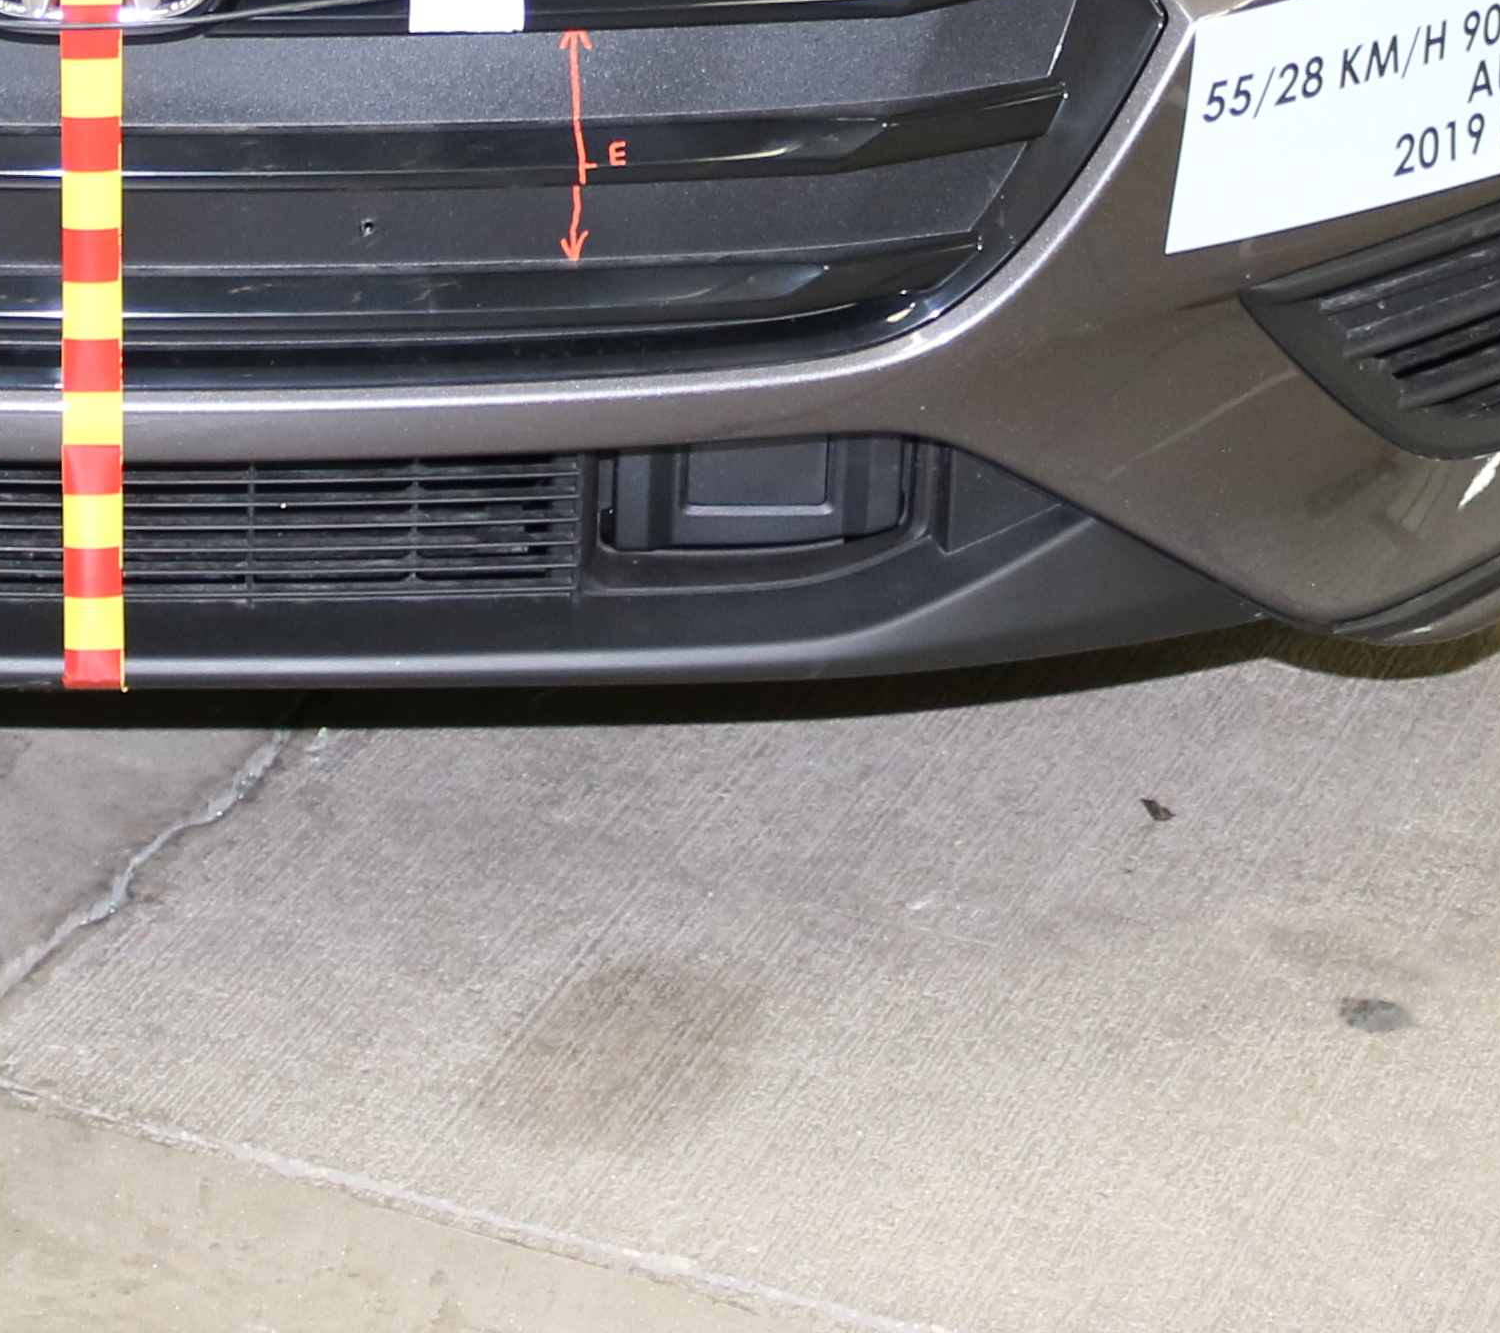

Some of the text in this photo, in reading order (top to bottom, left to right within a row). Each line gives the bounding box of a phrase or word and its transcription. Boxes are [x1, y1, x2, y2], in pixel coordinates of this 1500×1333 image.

[1202, 57, 1323, 123] 55/28
[1339, 21, 1447, 88] KM/H
[608, 140, 627, 167] E
[1394, 112, 1485, 176] 2019
